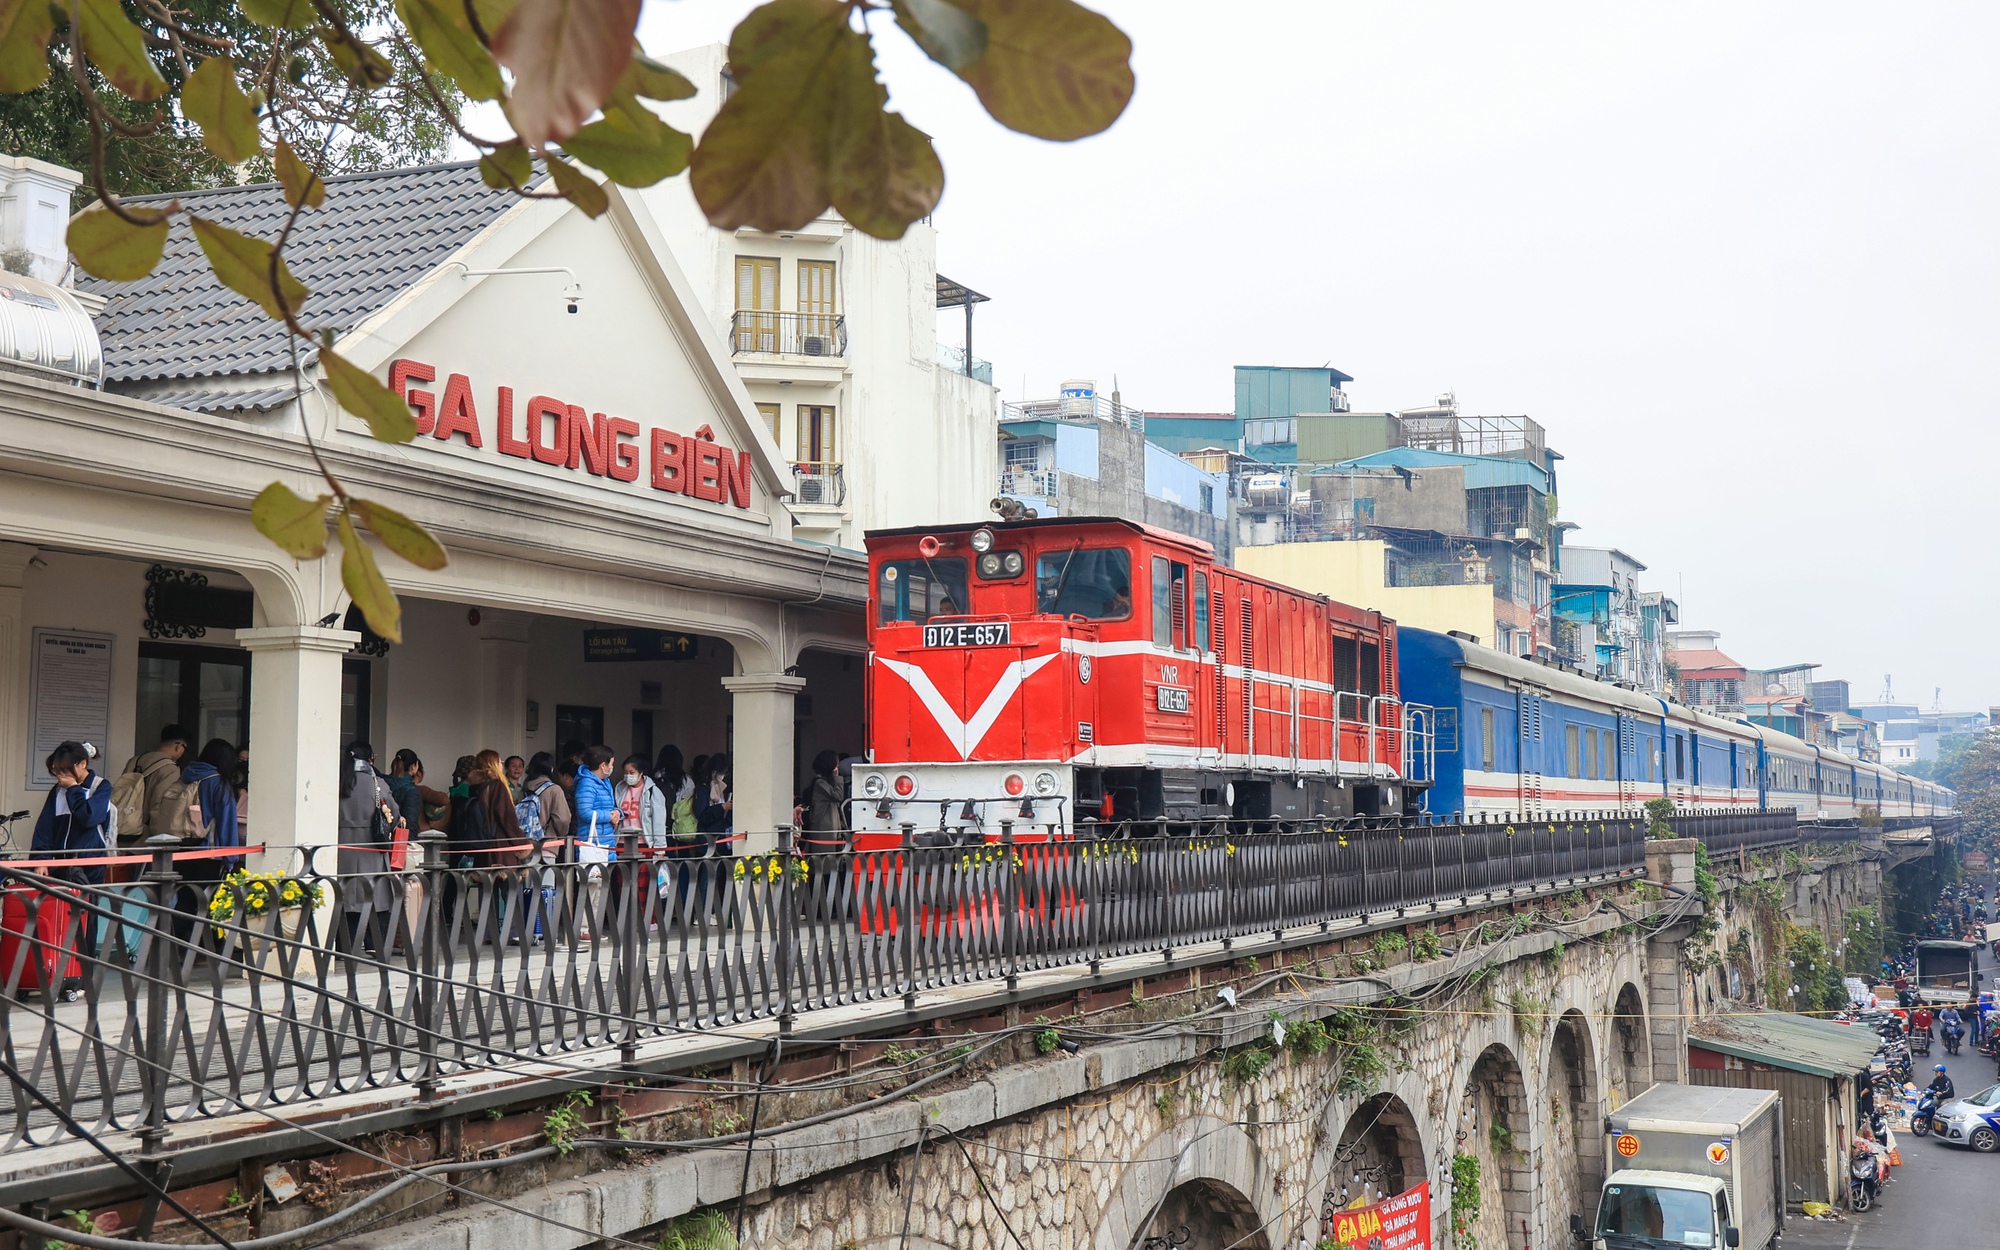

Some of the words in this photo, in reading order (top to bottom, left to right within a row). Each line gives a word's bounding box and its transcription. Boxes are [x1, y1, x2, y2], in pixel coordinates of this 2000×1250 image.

[387, 358, 483, 449] GA
[497, 386, 640, 482] LONG
[651, 424, 751, 509] BIÊN
[601, 638, 612, 646] RA
[1160, 663, 1179, 685] VNR
[1358, 1209, 1381, 1238] BIA
